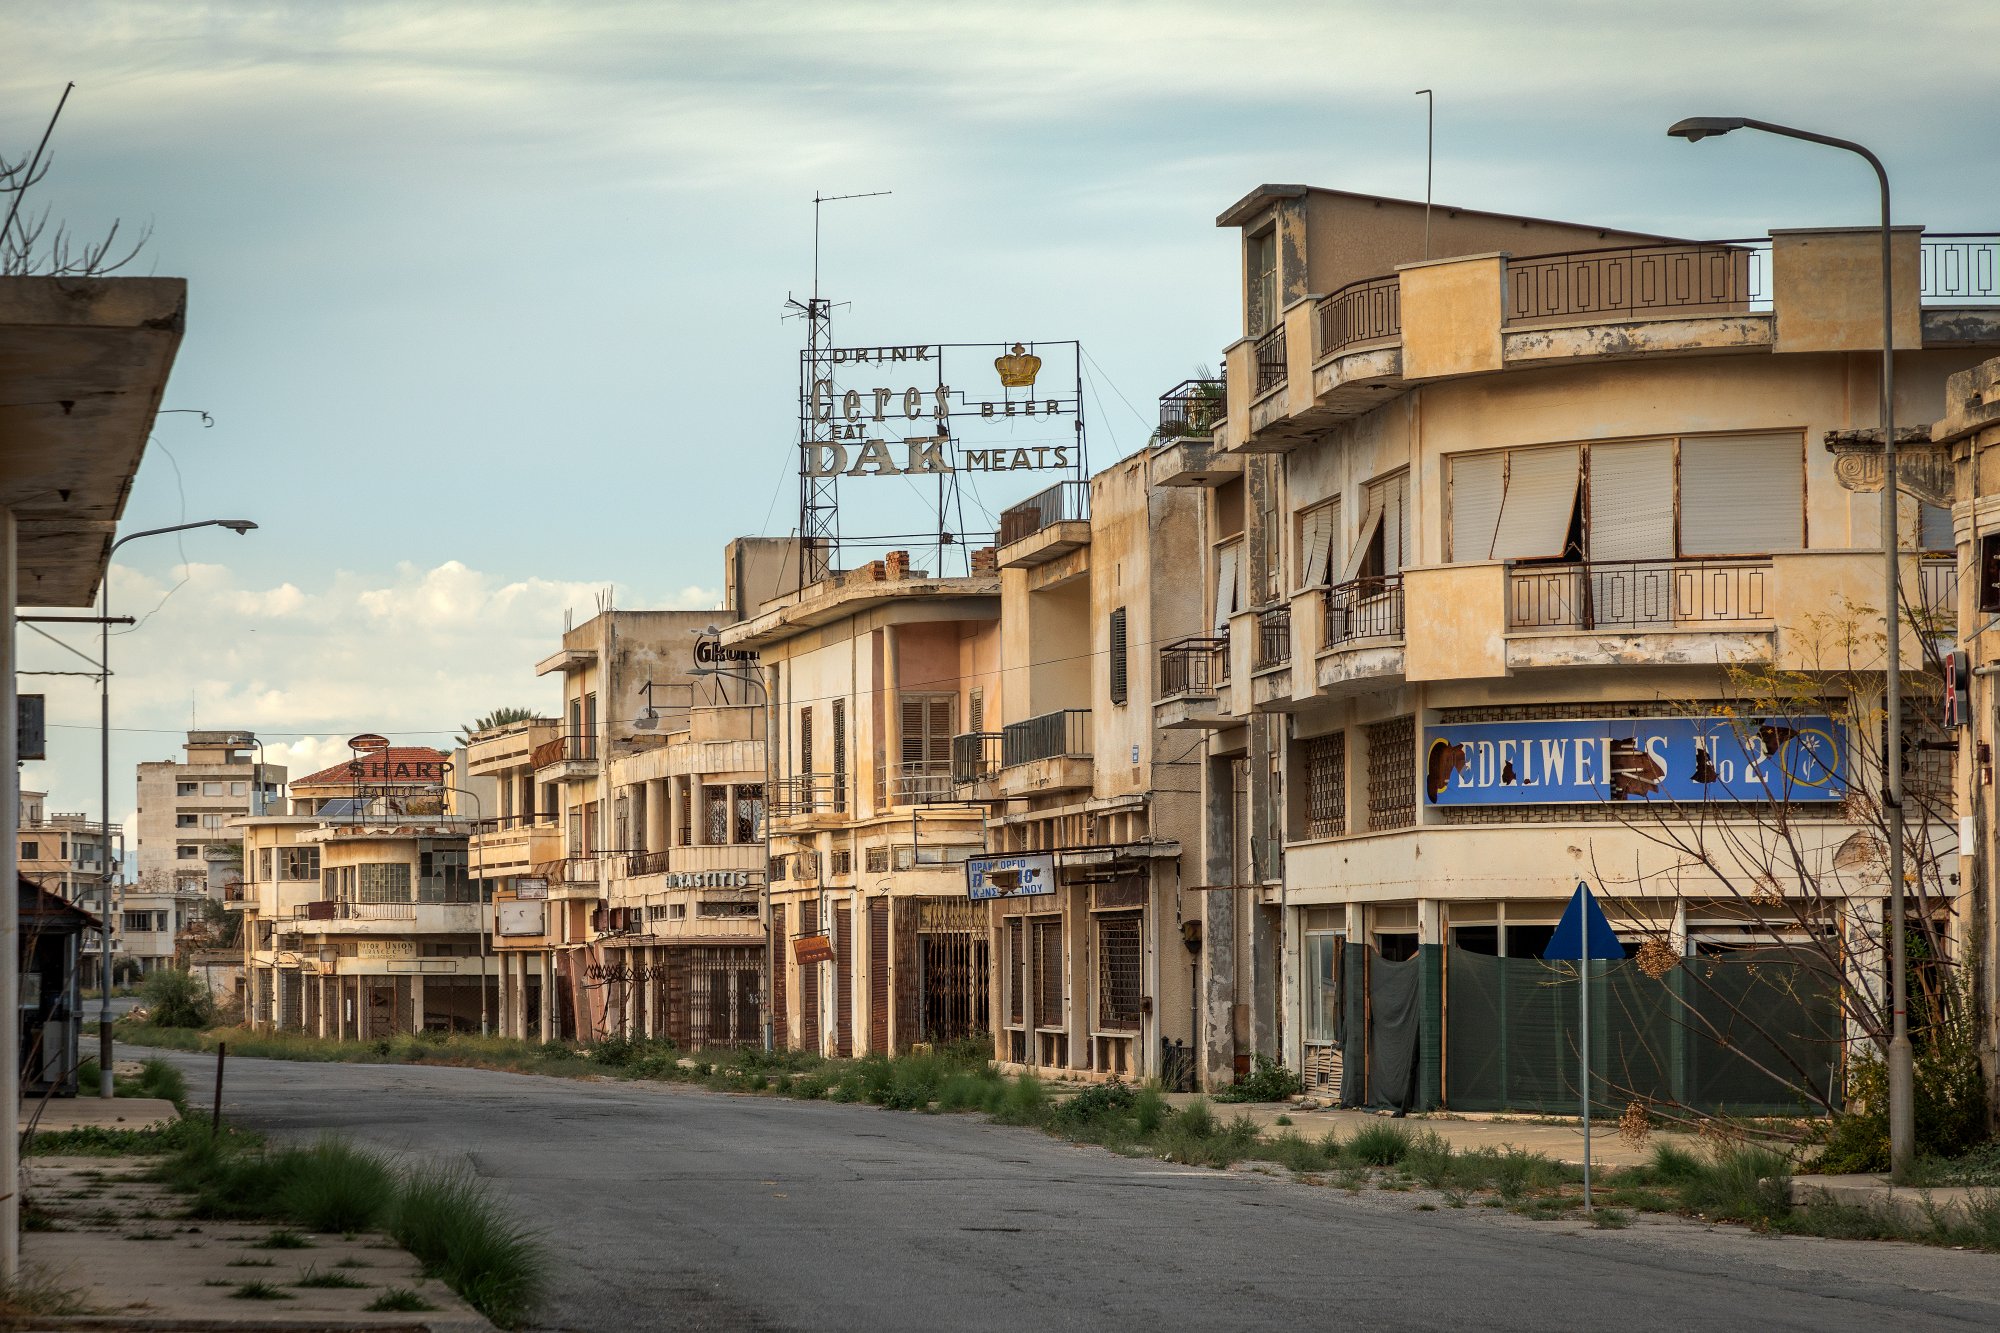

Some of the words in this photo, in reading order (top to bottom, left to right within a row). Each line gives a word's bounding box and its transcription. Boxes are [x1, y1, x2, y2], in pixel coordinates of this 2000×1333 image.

[833, 346, 930, 364] DRINK
[810, 379, 950, 424] Ceres
[981, 399, 1060, 417] BEER
[832, 423, 867, 440] EAT
[802, 435, 954, 478] DAK
[966, 445, 1068, 472] MEATS
[348, 761, 455, 778] SHARP
[1457, 735, 1668, 788] EDELWEIS
[1745, 735, 1769, 784] 2
